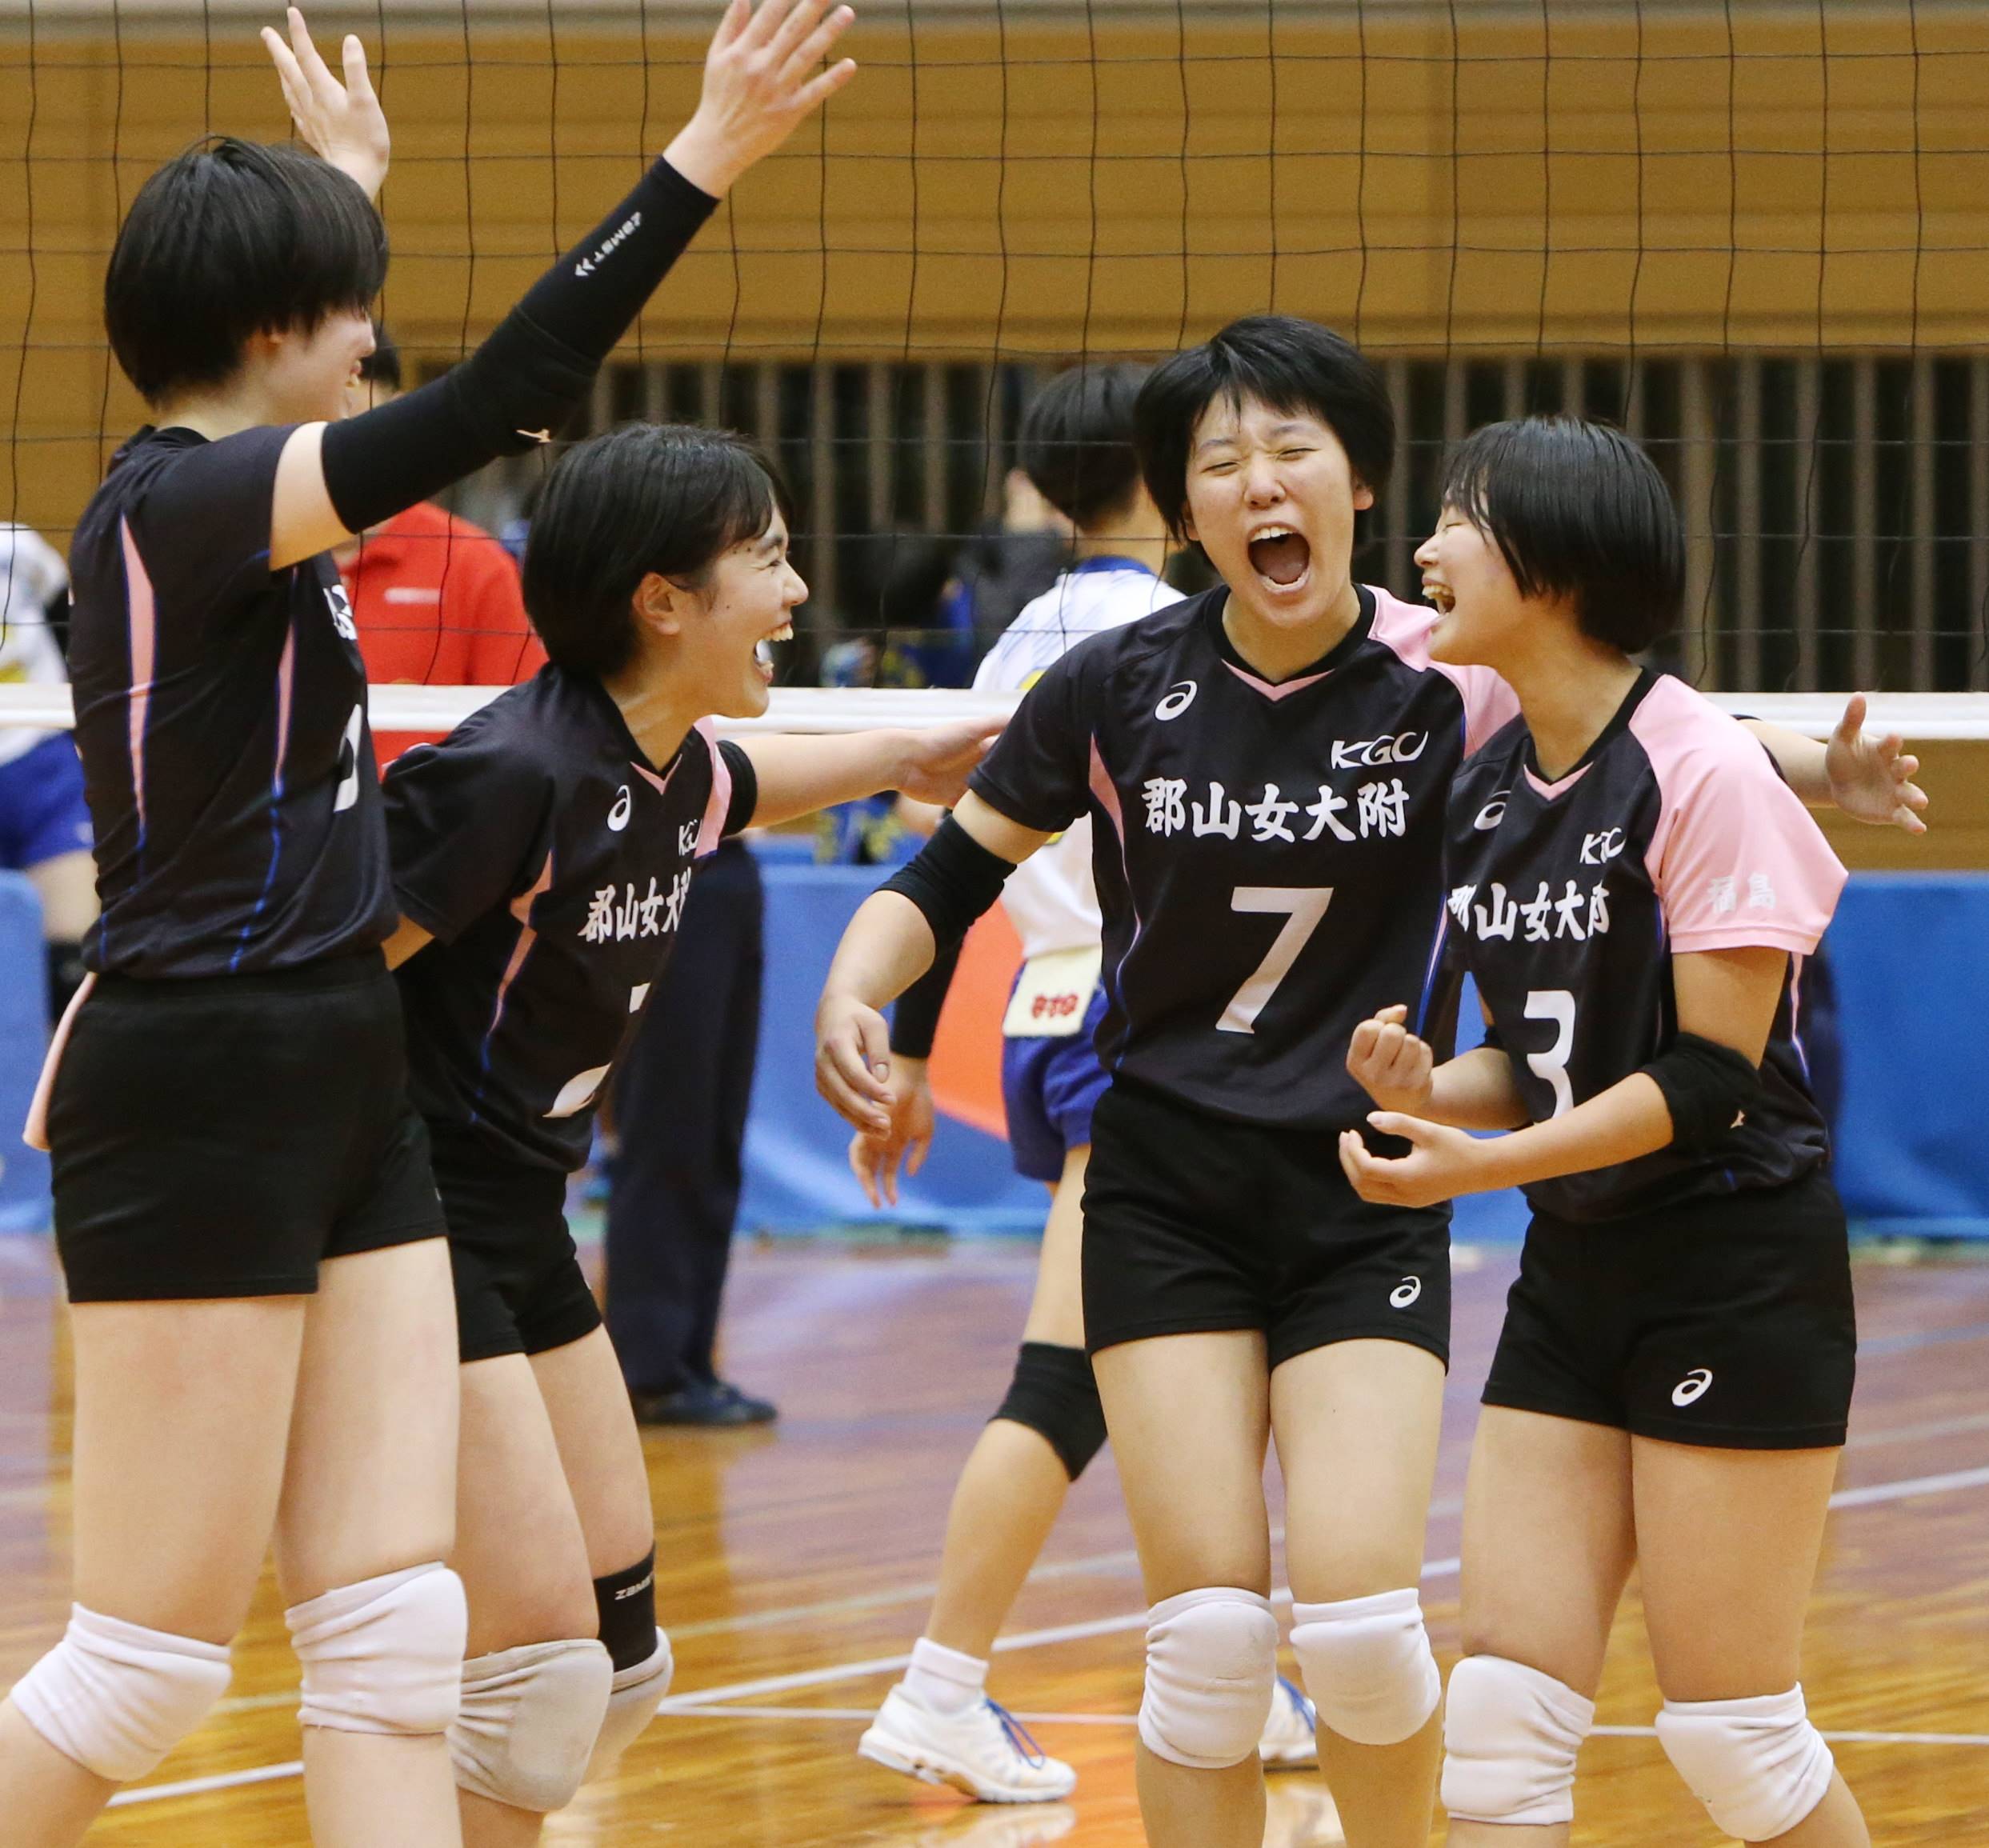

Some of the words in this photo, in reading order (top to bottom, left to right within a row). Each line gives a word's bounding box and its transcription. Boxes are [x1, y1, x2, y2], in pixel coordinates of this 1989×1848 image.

[1331, 731, 1428, 769] KGC
[1141, 777, 1411, 842] 郡山女大附
[1215, 886, 1335, 1034] 7
[1523, 990, 1576, 1119] 3
